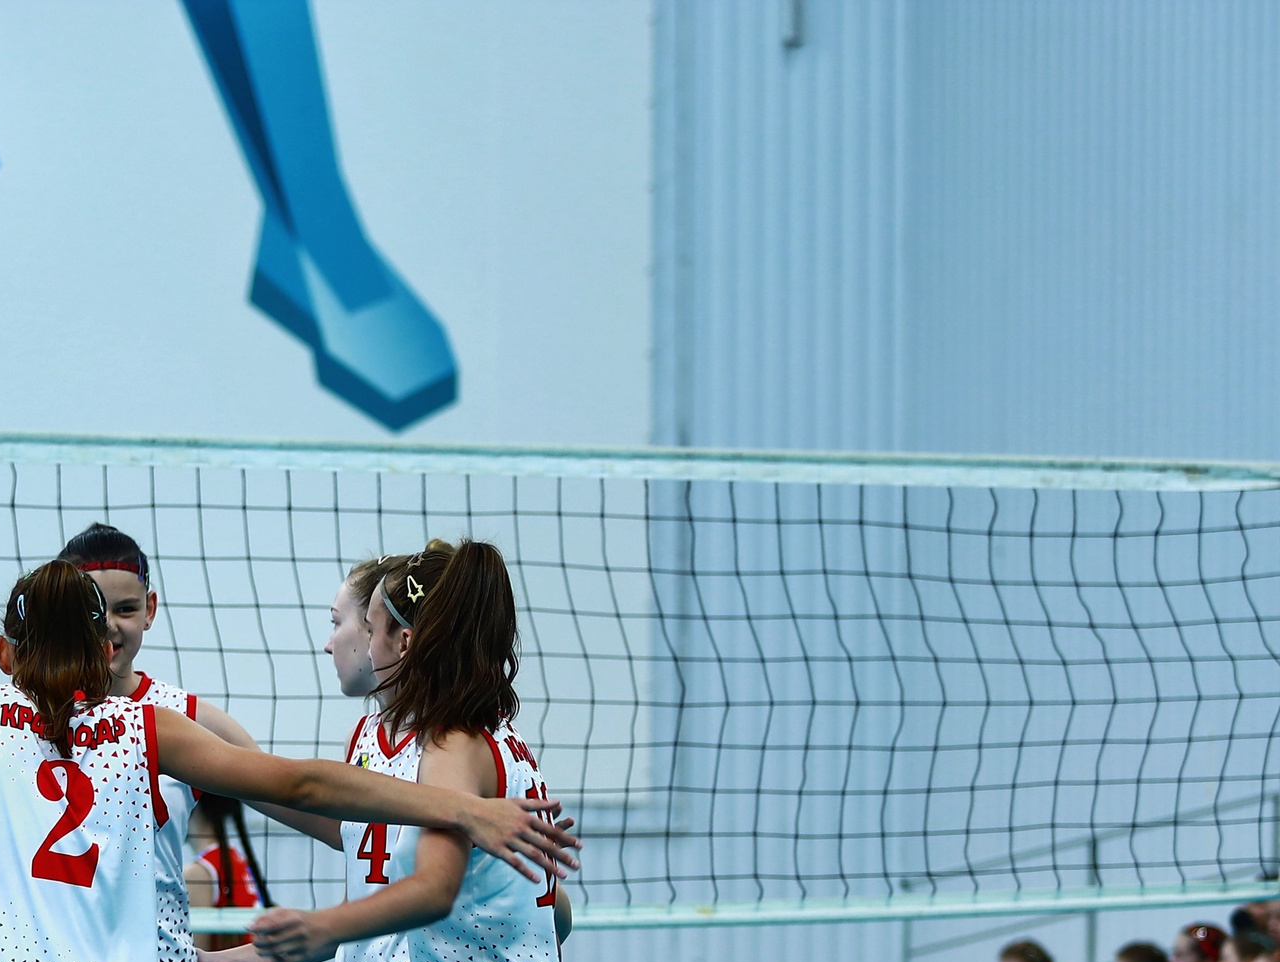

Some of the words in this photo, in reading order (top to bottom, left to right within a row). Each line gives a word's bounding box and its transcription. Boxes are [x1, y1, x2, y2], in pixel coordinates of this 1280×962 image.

[0, 702, 126, 750] КРАОДАР
[30, 758, 100, 889] 2
[357, 822, 391, 885] 4
